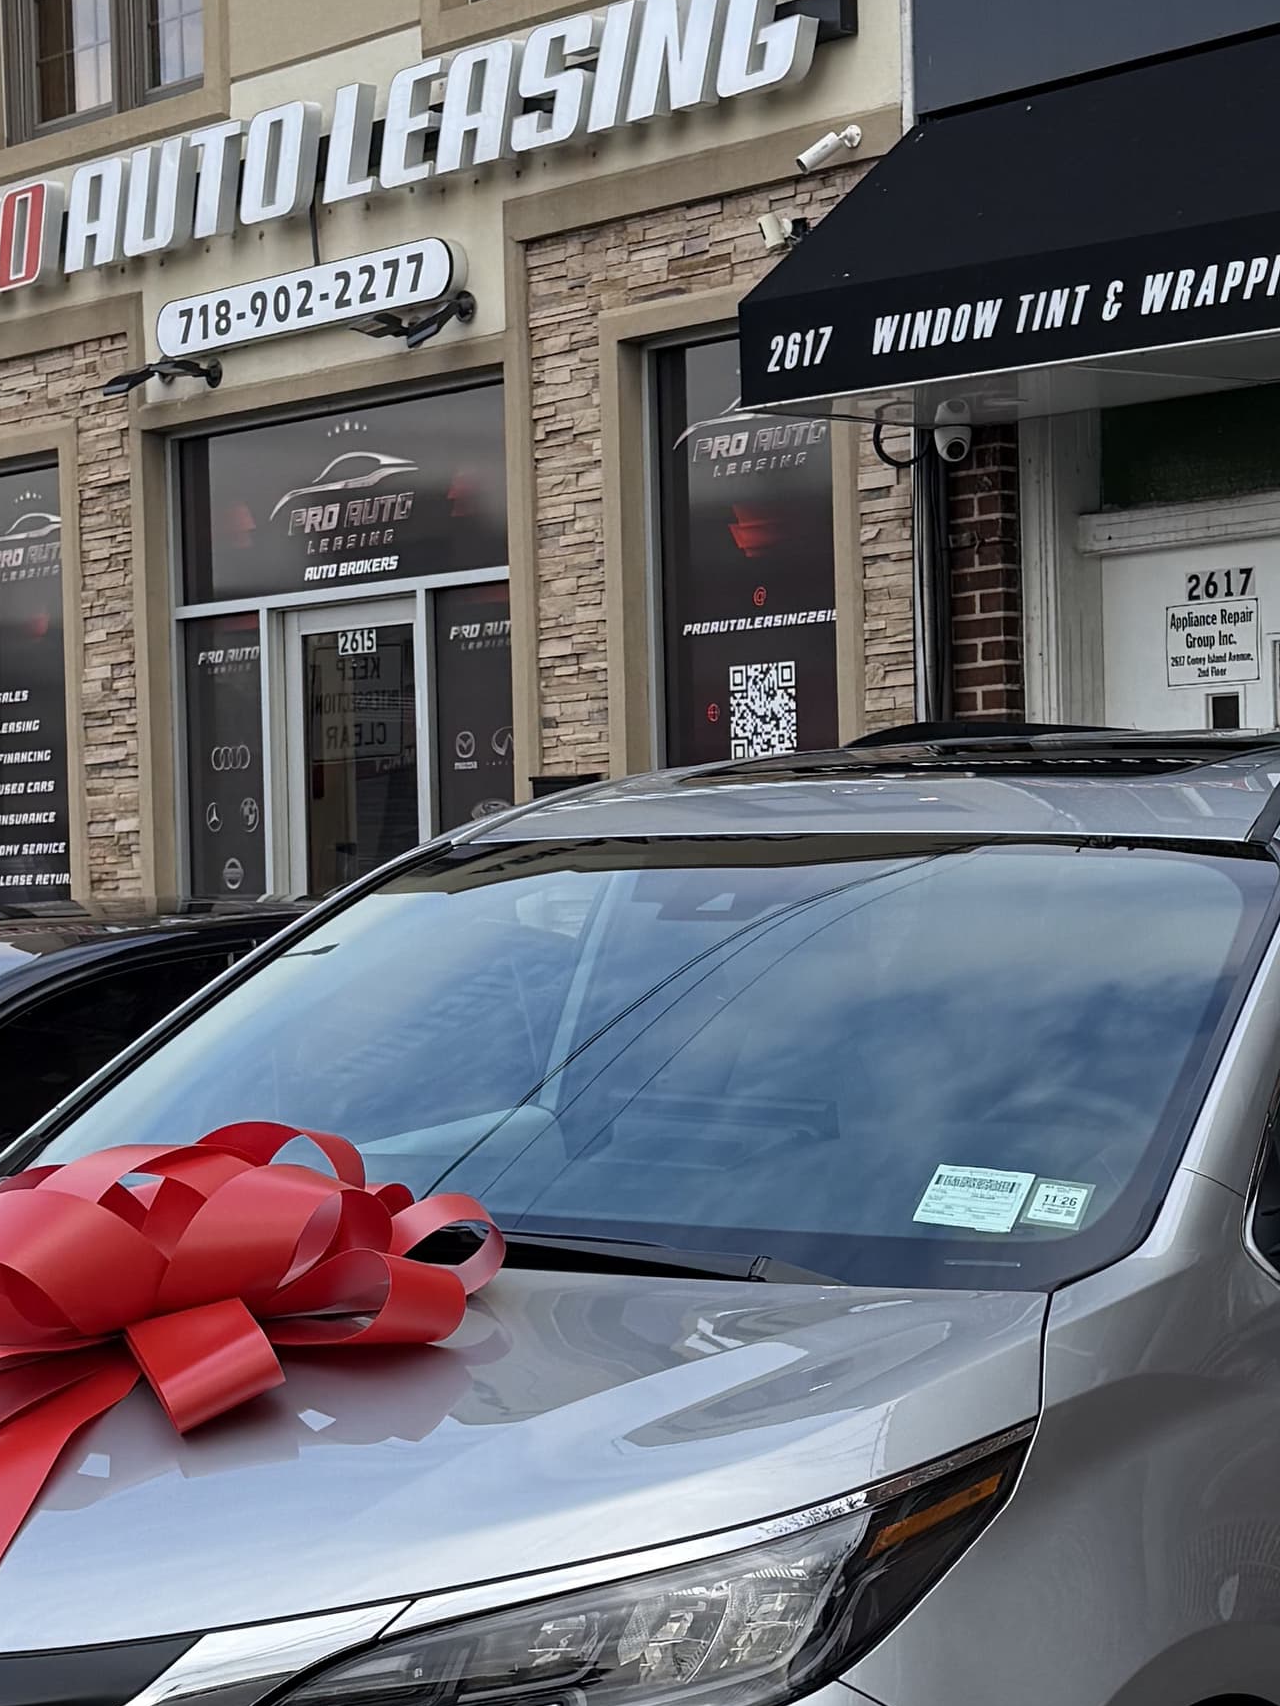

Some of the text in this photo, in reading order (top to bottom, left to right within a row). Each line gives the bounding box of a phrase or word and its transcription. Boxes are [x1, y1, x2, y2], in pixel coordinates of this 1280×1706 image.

[63, 99, 321, 275] AUTO
[176, 251, 427, 348] 718-902-2277
[766, 325, 834, 374] 2617
[871, 297, 1004, 356] WINDOW
[1016, 282, 1091, 334] TINT
[1101, 279, 1125, 323] &
[692, 418, 827, 462] PRO AUTO
[712, 451, 808, 478] LEASING
[288, 491, 415, 537] PRO AUTO
[26, 541, 62, 565] AUT
[307, 528, 395, 555] LEASING
[304, 555, 400, 582] AUTO BROKERS
[1187, 567, 1254, 601] 2617
[449, 619, 512, 641] PRO AUT
[1170, 606, 1254, 632] Appliance Repair
[339, 629, 375, 654] 2615
[1185, 633, 1216, 650] Group
[26, 780, 55, 793] CARS
[21, 841, 66, 856] SERVICE
[0, 872, 72, 887] LEASE RETUR
